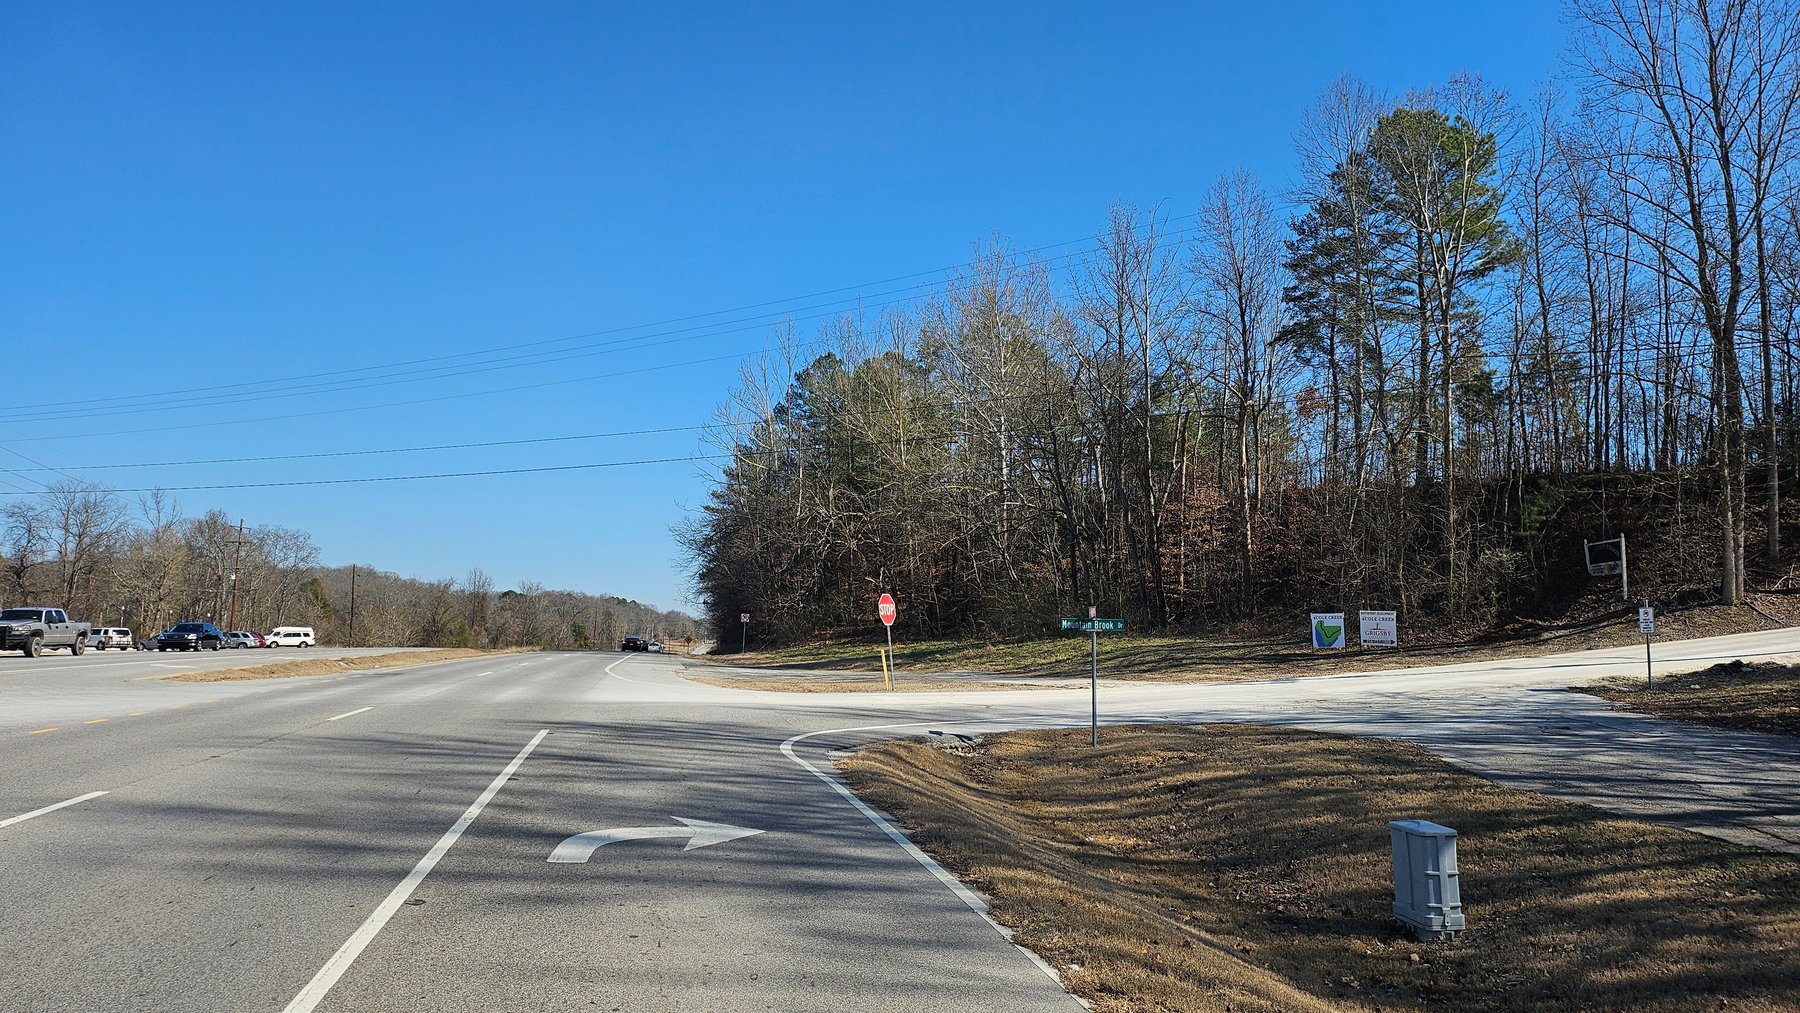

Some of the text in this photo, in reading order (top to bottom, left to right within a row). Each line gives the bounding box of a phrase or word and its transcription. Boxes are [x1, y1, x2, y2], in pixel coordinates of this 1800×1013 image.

[879, 603, 895, 616] STOP
[1062, 619, 1092, 629] Mountain
[1094, 620, 1114, 630] Brook
